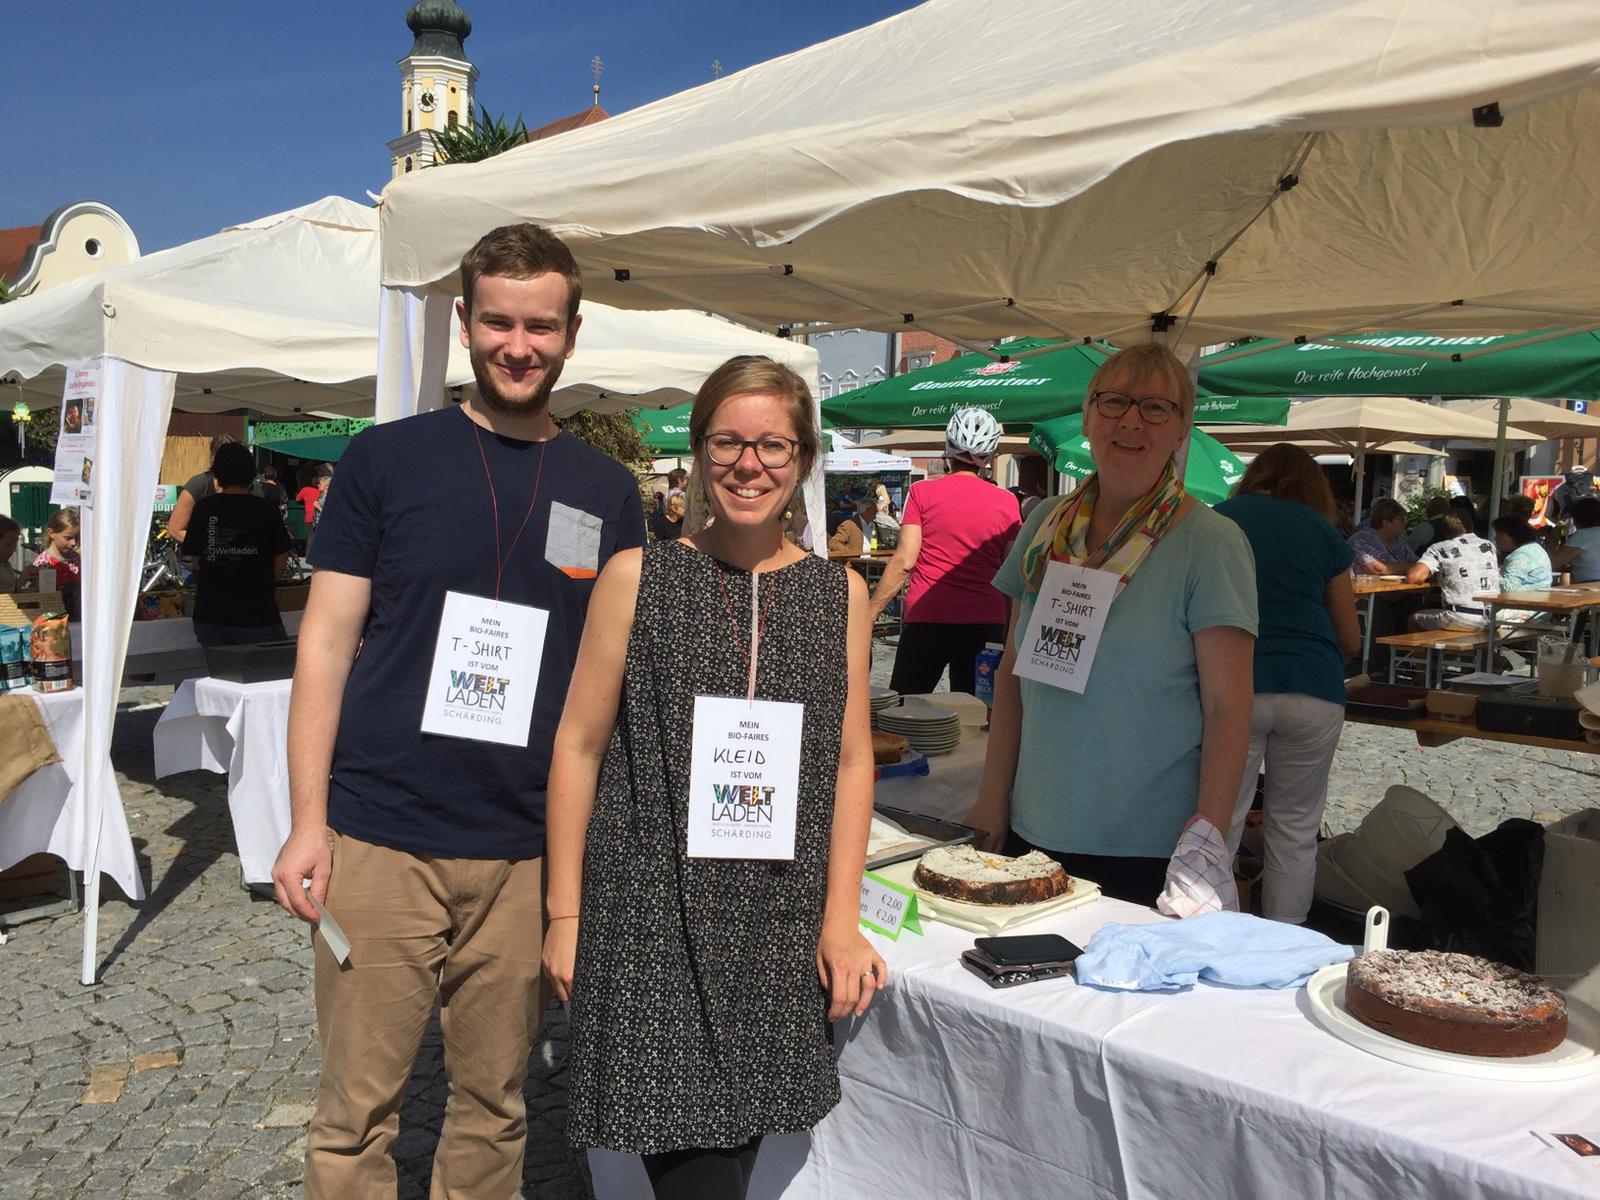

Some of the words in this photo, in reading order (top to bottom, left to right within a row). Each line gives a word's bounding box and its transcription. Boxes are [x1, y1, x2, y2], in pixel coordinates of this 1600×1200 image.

[1294, 370, 1314, 384] Der
[1318, 369, 1345, 382] reife
[1347, 362, 1427, 380] Hochgenuss!
[909, 377, 1053, 391] Baumgartner
[912, 406, 928, 417] Der
[929, 404, 947, 415] reife
[1575, 401, 1584, 412] P
[1071, 581, 1088, 590] MEIN
[1061, 588, 1092, 600] BIO-FAIRES
[481, 617, 501, 627] MEIN
[1055, 617, 1064, 625] IST
[1064, 619, 1079, 629] VOM
[469, 626, 510, 639] BIO-FAIRES
[1041, 625, 1087, 650] WELT
[1033, 638, 1081, 663] LADEN
[468, 660, 479, 668] IST
[480, 661, 499, 671] VOM
[450, 669, 510, 696] WELT
[446, 686, 506, 711] LADEN
[739, 721, 760, 729] MEIN
[728, 731, 769, 742] BIO-FAIRES
[713, 747, 766, 765] KLEID
[730, 771, 741, 779] IST
[743, 771, 762, 780] VOM
[713, 783, 775, 806] WELT
[711, 803, 773, 823] LADEN
[881, 894, 903, 911] €2,00
[876, 908, 897, 926] €2,00
